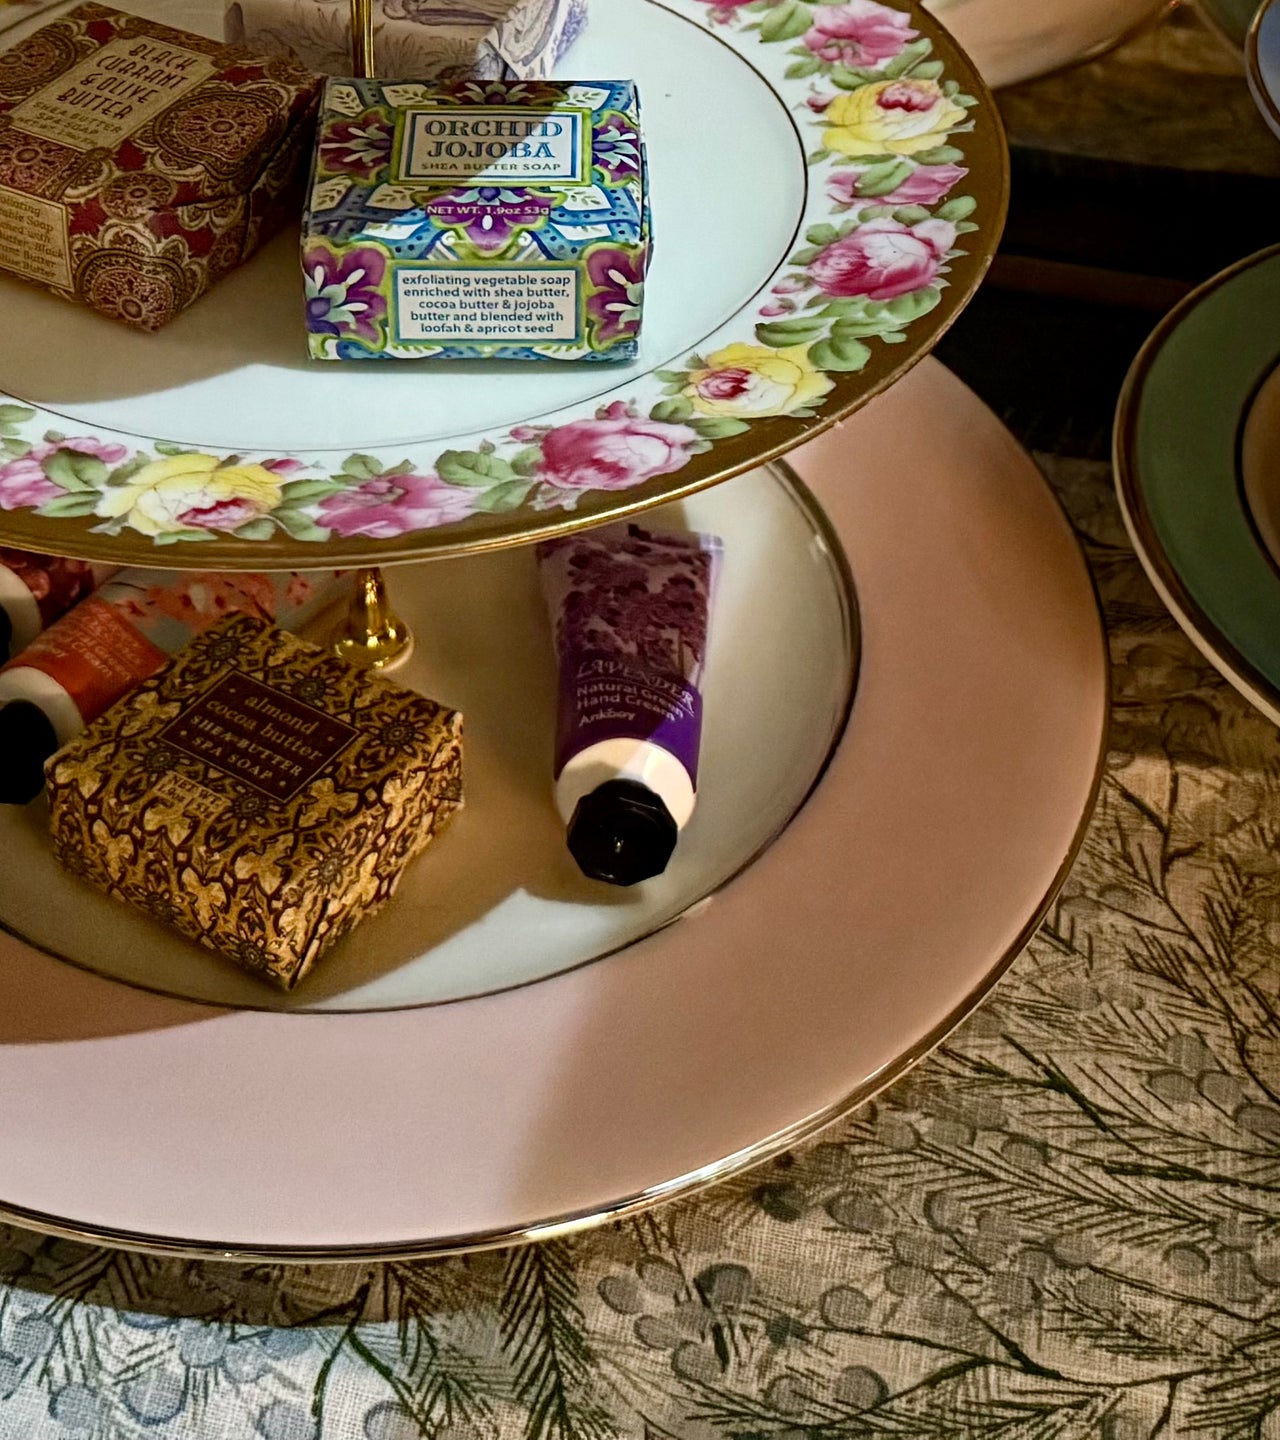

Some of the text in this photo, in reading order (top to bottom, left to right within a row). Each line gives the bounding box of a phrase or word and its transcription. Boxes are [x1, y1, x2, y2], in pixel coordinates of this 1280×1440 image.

[129, 43, 198, 71] BLACK
[96, 55, 189, 89] CURRANT
[97, 76, 159, 104] OLIVE
[56, 87, 134, 119] BUTTER
[425, 120, 563, 137] ORCHID
[427, 141, 556, 158] JOJOBA
[422, 163, 458, 171] SHEA
[523, 163, 561, 171] SOAP
[427, 206, 549, 215] NET WT. 1.9oz 53g
[402, 274, 571, 287] exfoliating vegetable soap
[403, 287, 570, 298] enriched with shea butter,
[419, 299, 554, 311] cocoa butter & jojoba
[410, 312, 564, 321] butter and blended with
[421, 324, 554, 335] loofah & apricot seed
[577, 683, 684, 719] Natural Green
[577, 693, 676, 721] Hand Cream
[244, 696, 320, 735] almond
[206, 700, 323, 761] cocoa butter
[191, 737, 273, 780] SPA SOAP
